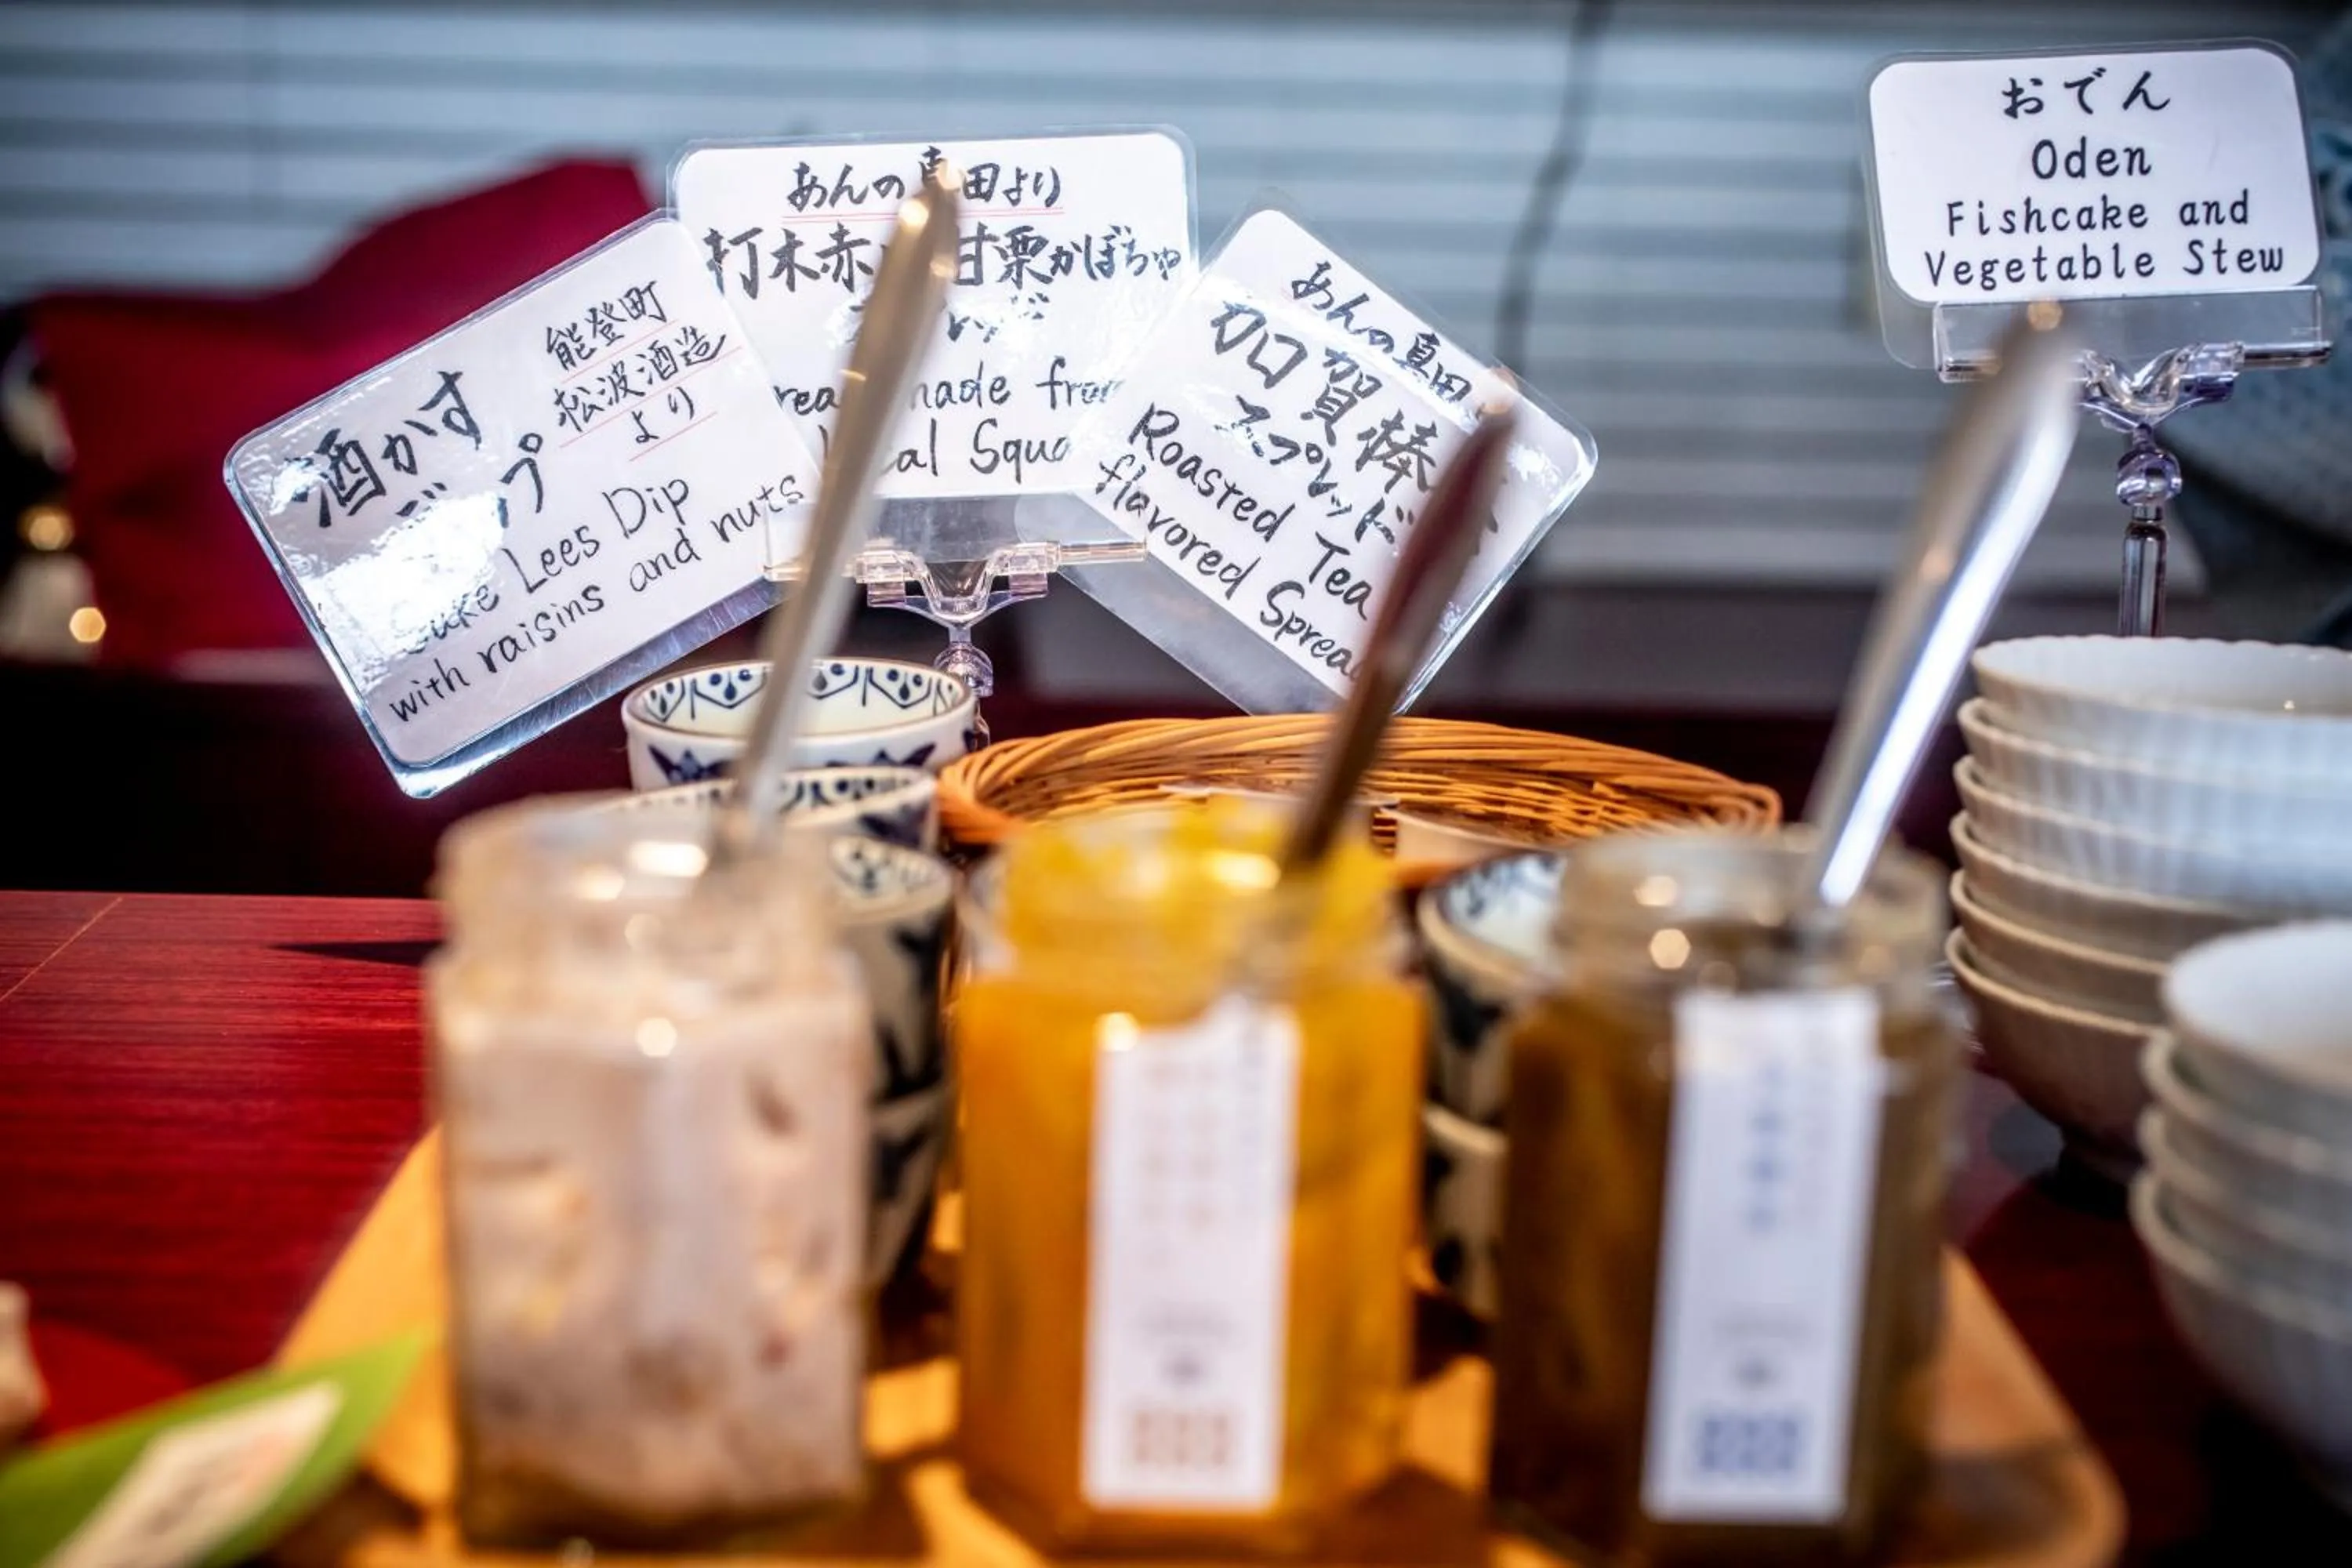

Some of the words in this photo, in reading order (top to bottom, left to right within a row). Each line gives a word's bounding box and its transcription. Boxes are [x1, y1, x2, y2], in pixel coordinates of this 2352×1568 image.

[2001, 66, 2171, 119] おでん
[2031, 136, 2152, 180] Oden
[1947, 194, 2149, 237] Fishcake
[2179, 188, 2249, 227] and
[703, 220, 1181, 299] 打木赤甘栗かぼちゃ
[1925, 242, 2155, 292] Vegetable
[2183, 239, 2285, 276] Stew
[546, 281, 667, 372] 能登町
[554, 326, 727, 434] 松波酒造
[633, 387, 695, 445] より
[284, 371, 482, 528] 酒かす
[502, 525, 601, 594] Lees
[601, 478, 690, 539] Dip
[1095, 453, 1261, 601] flavored
[1127, 401, 1297, 543] Roasted
[1308, 531, 1373, 622] Tea
[390, 658, 470, 723] with
[476, 584, 605, 674] raisins
[629, 527, 702, 593] and
[713, 474, 804, 543] nuts
